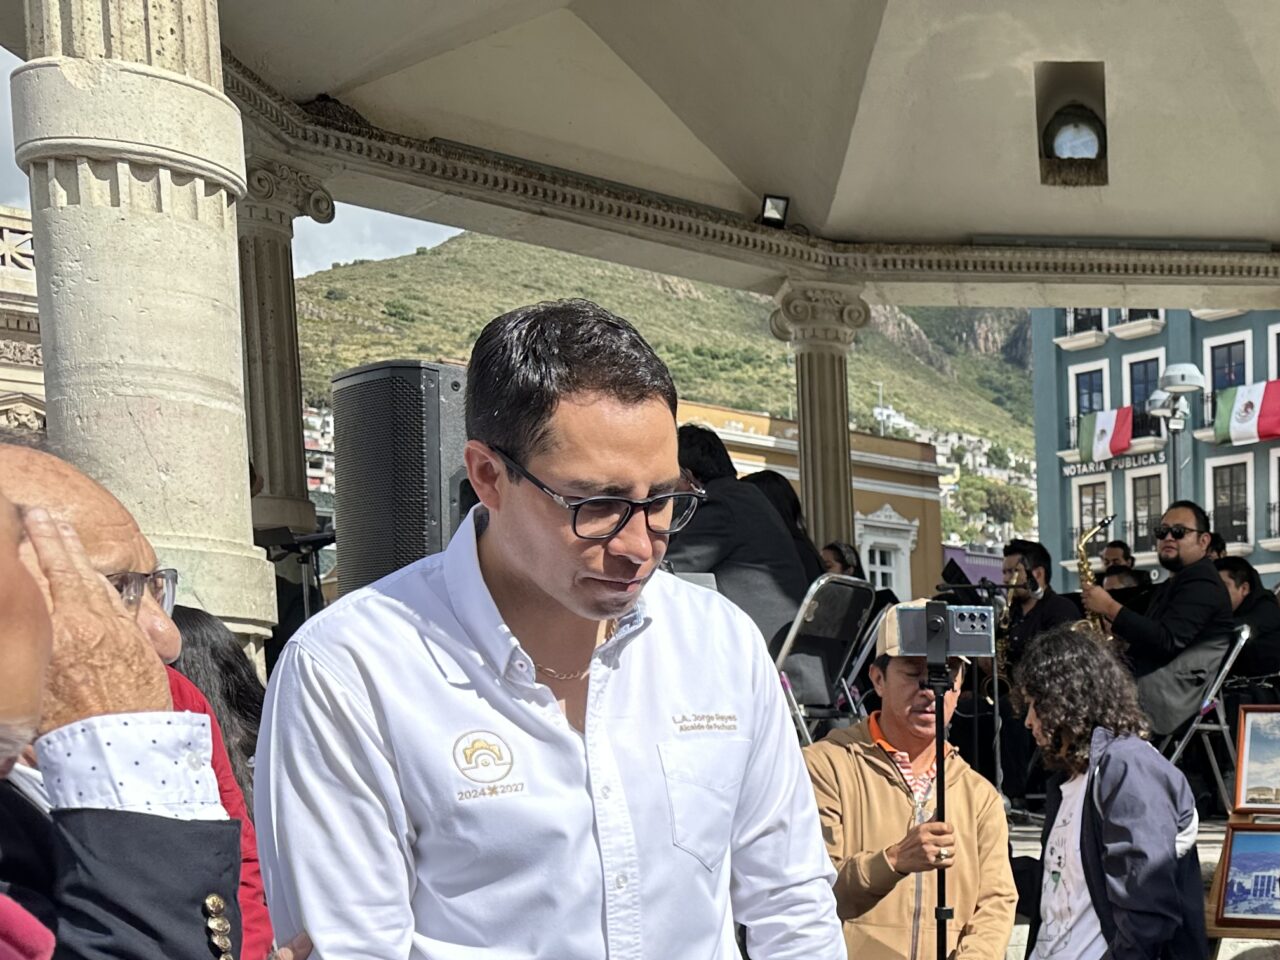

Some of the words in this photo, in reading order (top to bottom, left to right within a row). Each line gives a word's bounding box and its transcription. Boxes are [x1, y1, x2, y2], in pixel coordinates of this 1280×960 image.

[692, 713, 715, 723] Jorge
[715, 713, 737, 723] Reyes
[679, 722, 705, 732] Alcalde
[457, 787, 487, 801] 2024
[500, 783, 524, 793] 2027
